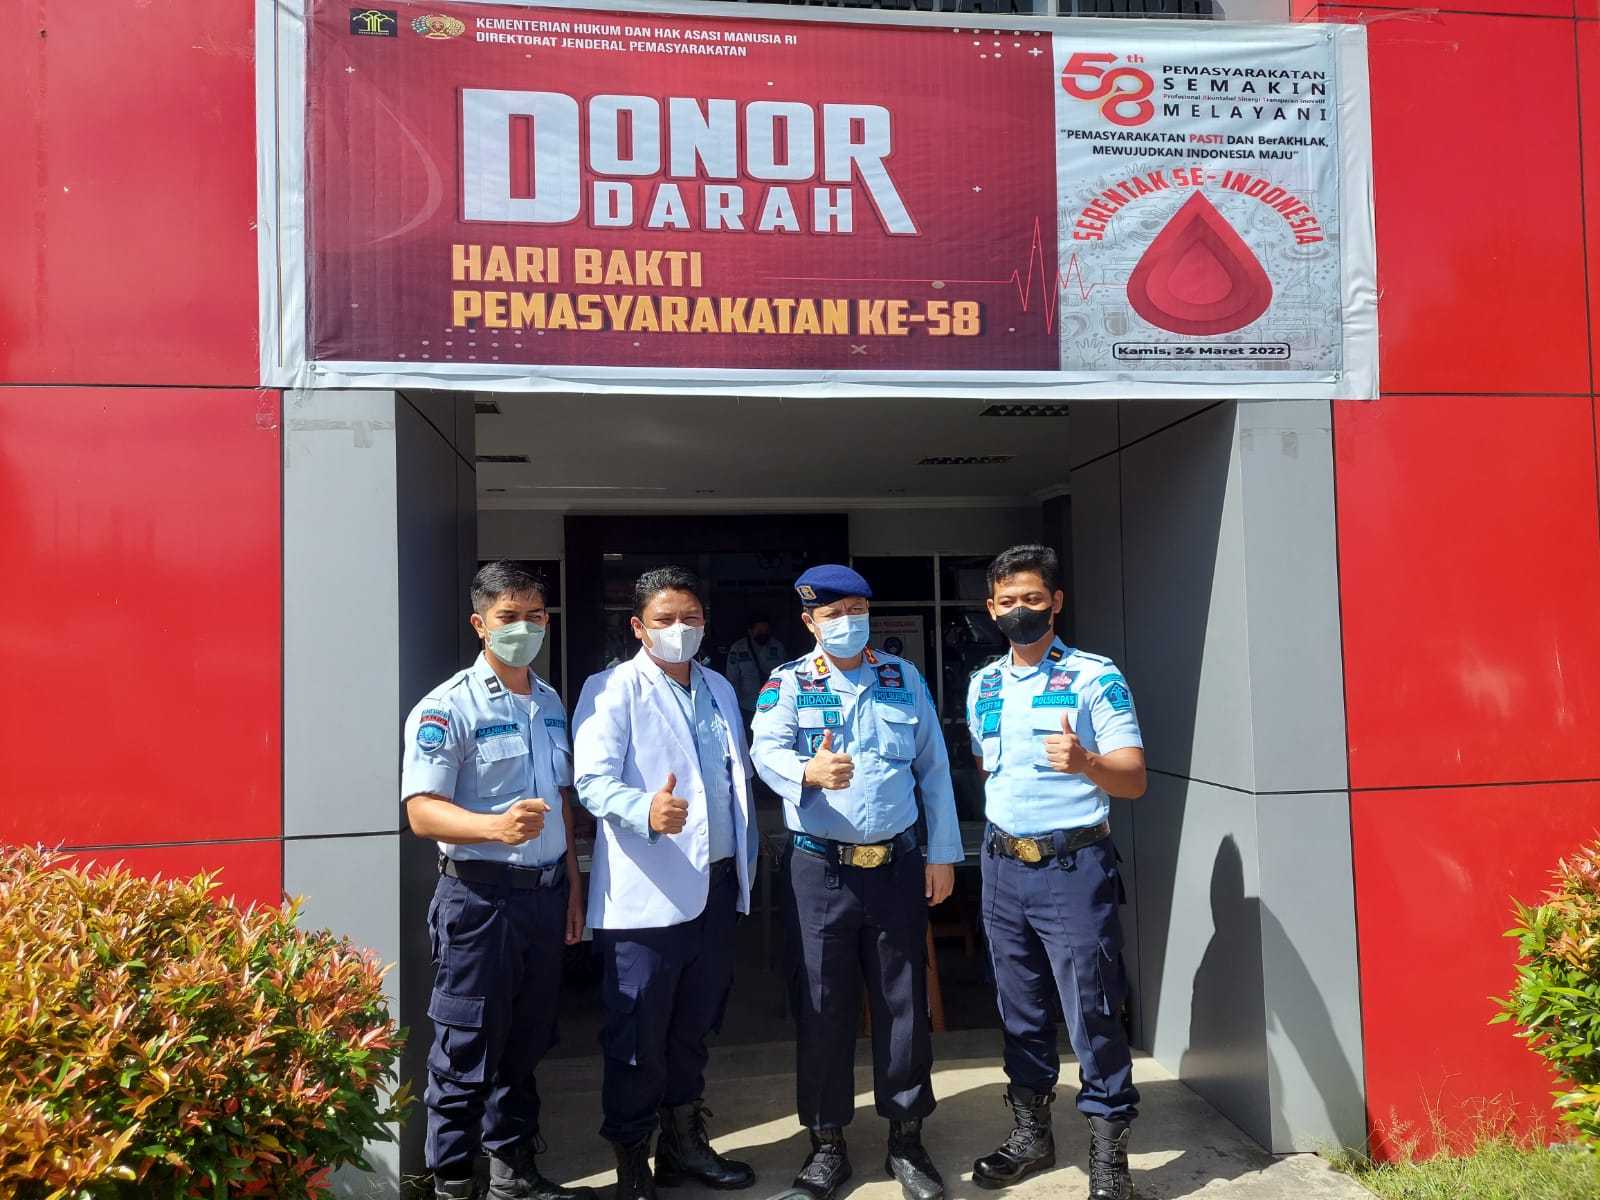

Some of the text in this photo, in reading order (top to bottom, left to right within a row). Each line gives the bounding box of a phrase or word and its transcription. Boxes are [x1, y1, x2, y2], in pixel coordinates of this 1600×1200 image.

[476, 18, 797, 45] KEMENTERIAN HUKUM DAN HAK ASASI MANUSIA RI
[476, 31, 747, 57] DIREKTORAT JENDERAL PEMASYARAKATAN
[1126, 54, 1144, 64] th
[1163, 65, 1326, 80] PEMASYARAKATAN
[1163, 77, 1326, 96] SEMAKIN
[1163, 103, 1327, 121] MELAYANI
[1189, 134, 1224, 144] PASTI
[1227, 135, 1255, 145] DAN
[1258, 135, 1328, 147] BerAKHLAK,
[463, 88, 918, 235] DONOR
[1093, 145, 1184, 157] MEWUJUDKAN
[1187, 148, 1255, 159] INDONESIA
[593, 181, 853, 234] DARAH
[1073, 168, 1170, 241] SERENTAK
[1221, 168, 1325, 246] INDONESIA
[452, 244, 702, 287] HARI BAKTI
[452, 290, 980, 336] PEMASYARAKATAN KE-58
[1118, 347, 1171, 355] Kamis,
[1199, 347, 1244, 355] Maret
[1250, 347, 1285, 355] 2022
